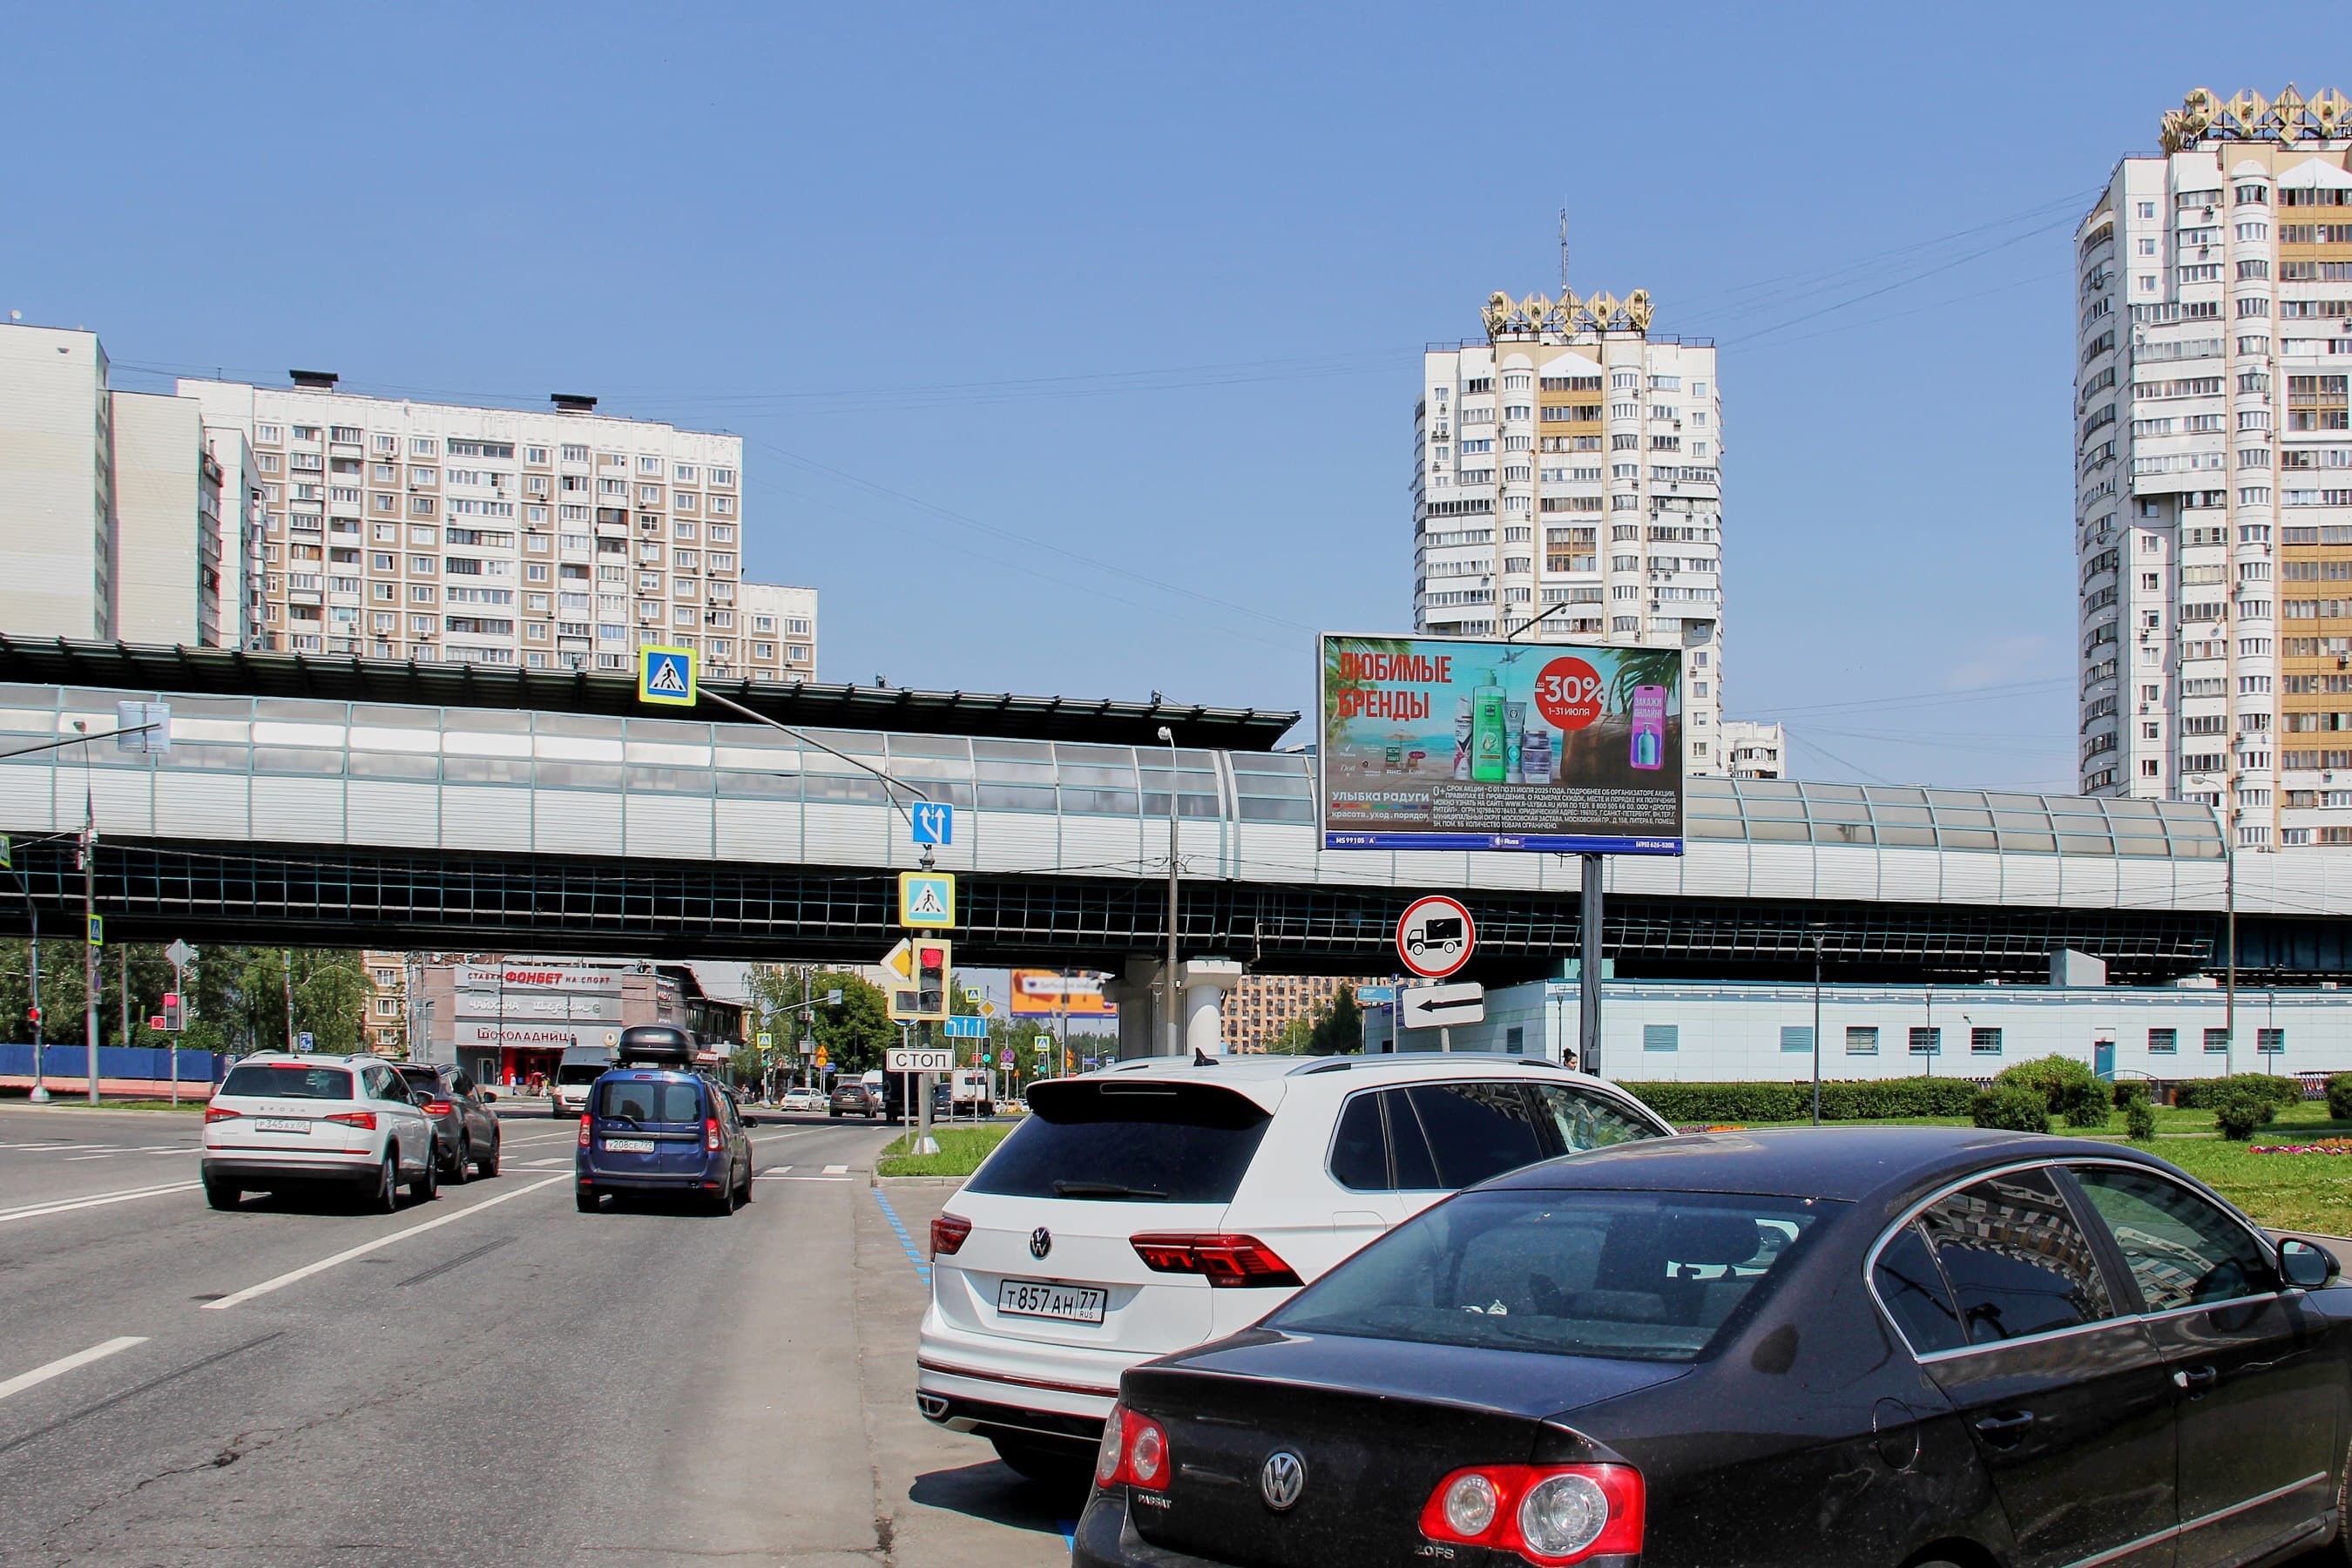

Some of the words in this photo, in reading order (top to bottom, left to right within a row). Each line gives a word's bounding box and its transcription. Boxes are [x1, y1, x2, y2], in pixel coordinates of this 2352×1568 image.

[1338, 652, 1452, 684] ЛЮБИМЫЕ
[1338, 689, 1429, 722] БРЕНДЫ
[1634, 697, 1662, 707] ЗАКАЖИ
[1433, 786, 1446, 796] 0+
[505, 971, 564, 984] ФОНБЕТ
[896, 1053, 947, 1068] СТОП
[1080, 1310, 1094, 1319] RUS
[1138, 1493, 1173, 1510] PASSAT
